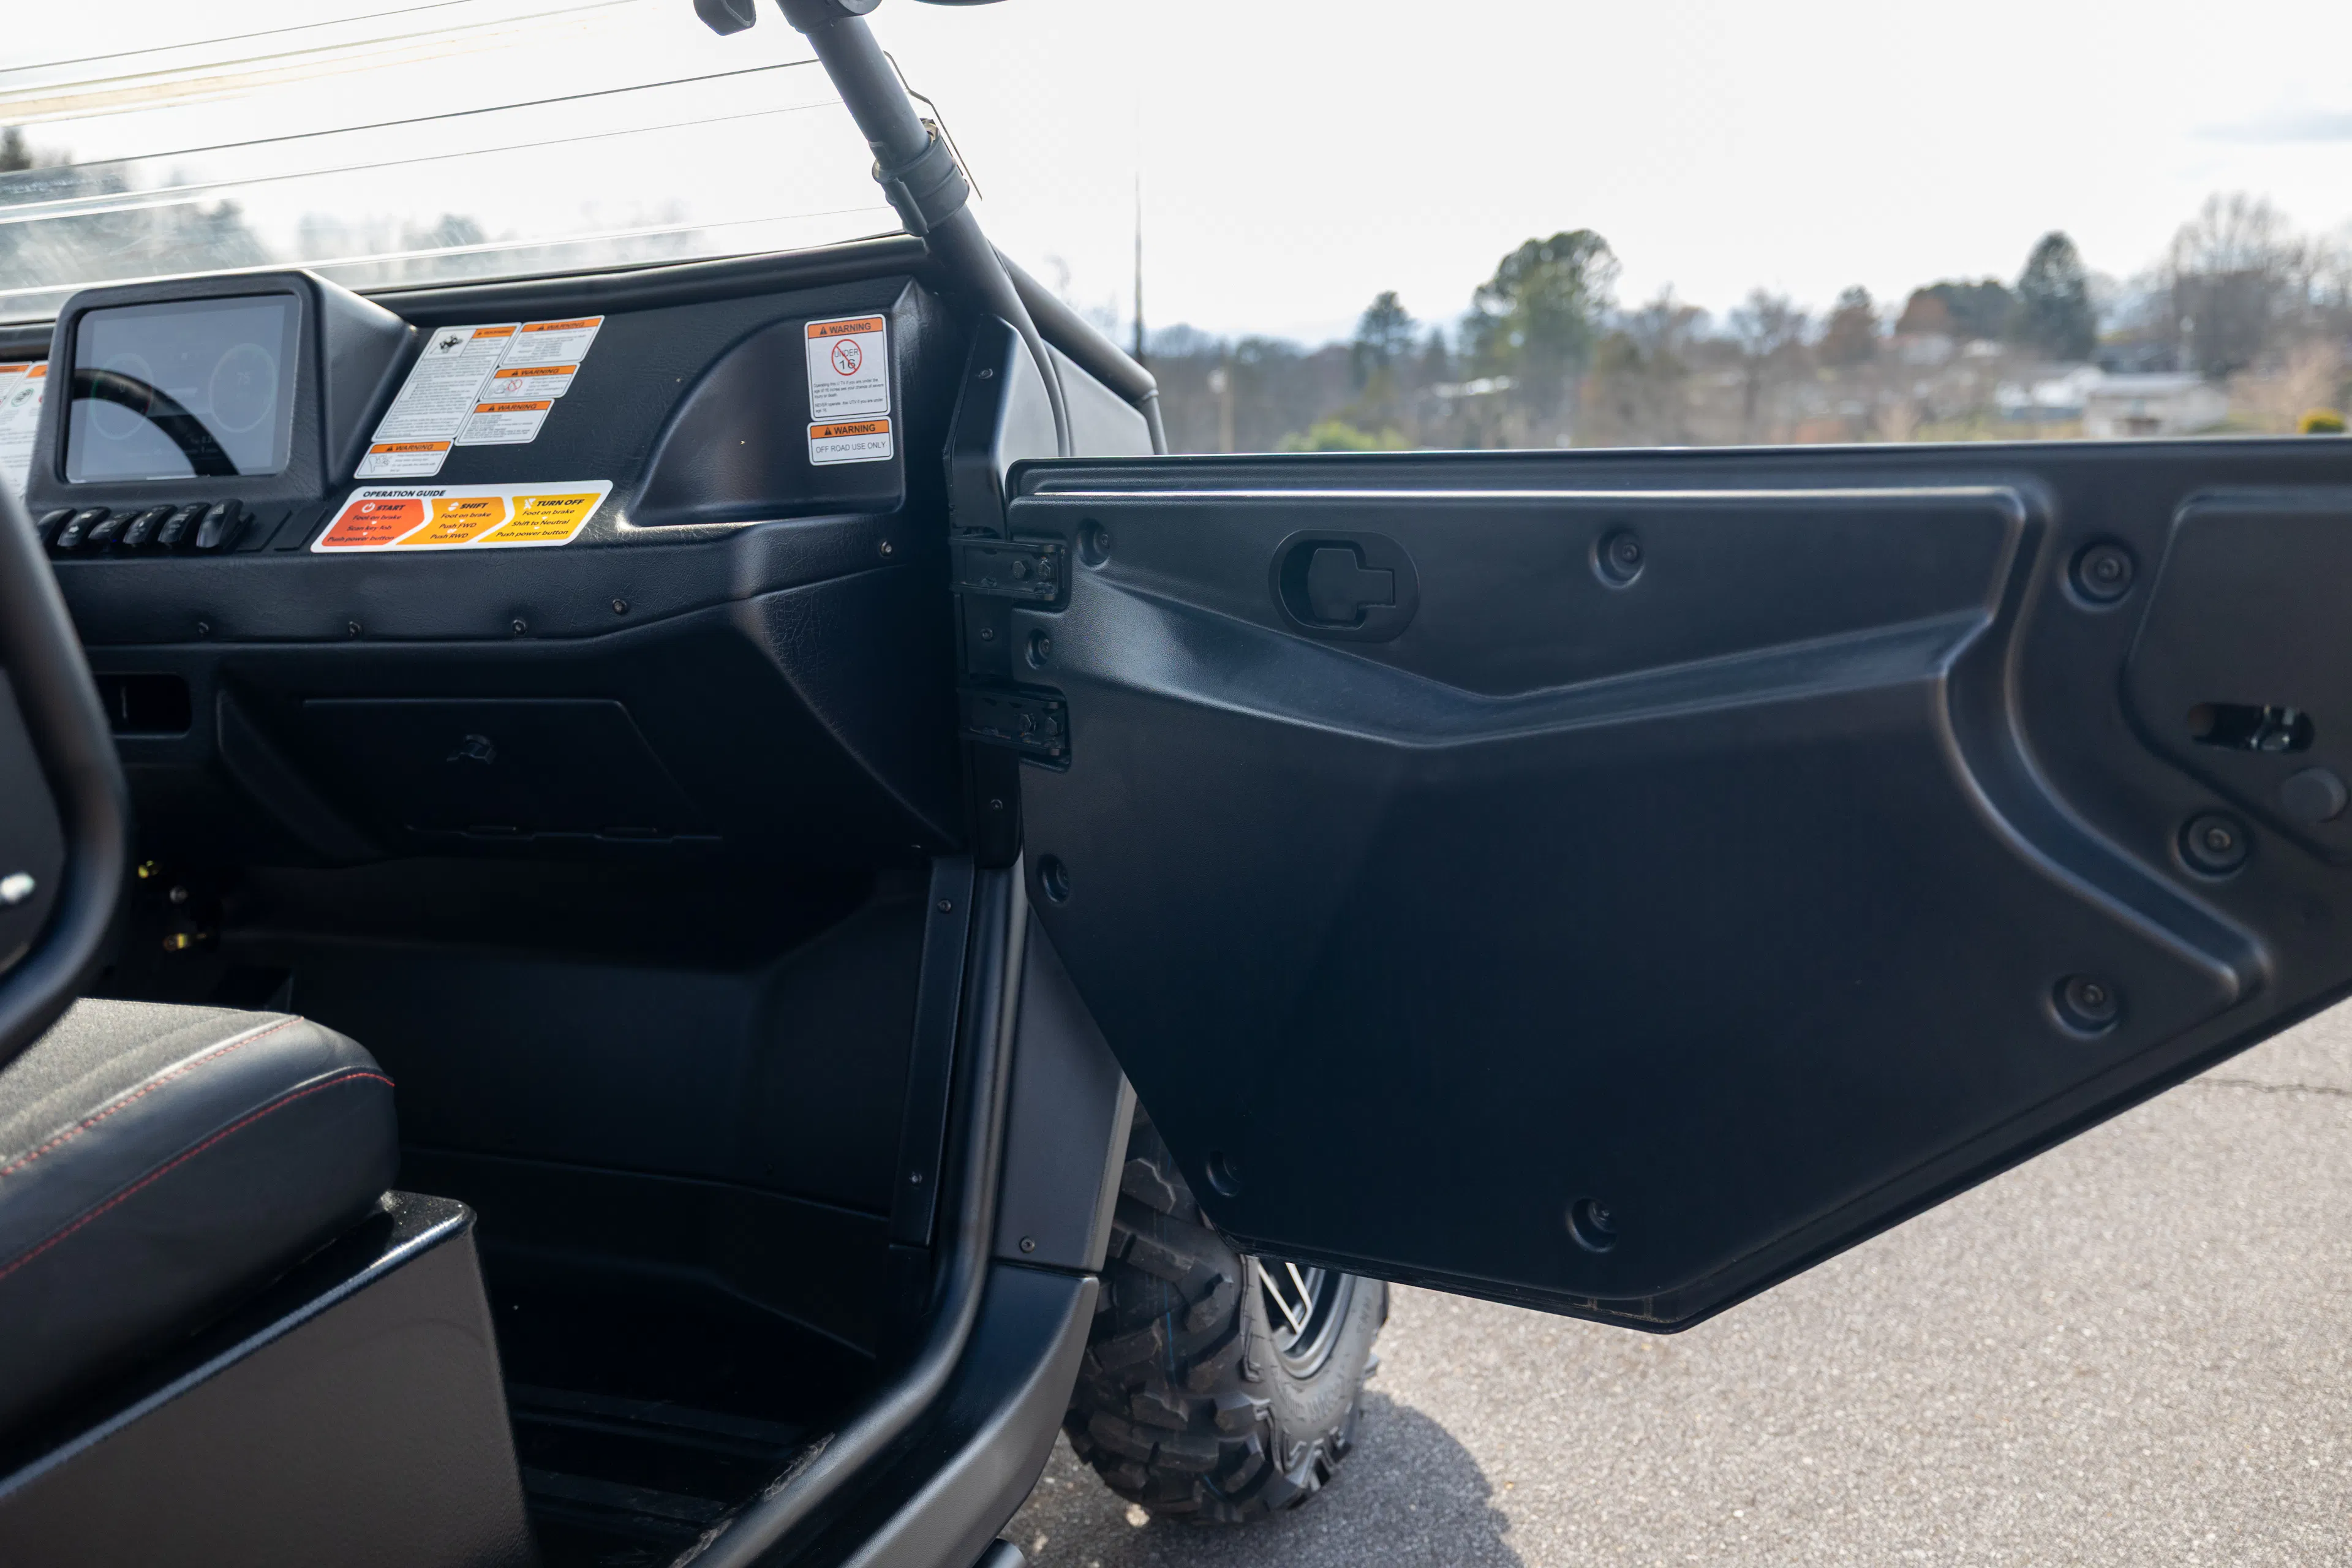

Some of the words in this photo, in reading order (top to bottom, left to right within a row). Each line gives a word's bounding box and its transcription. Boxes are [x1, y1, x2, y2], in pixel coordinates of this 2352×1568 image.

[829, 323, 871, 334] WARNING
[834, 348, 859, 358] UNDER
[839, 358, 856, 370] 16
[834, 424, 875, 435] WARNING
